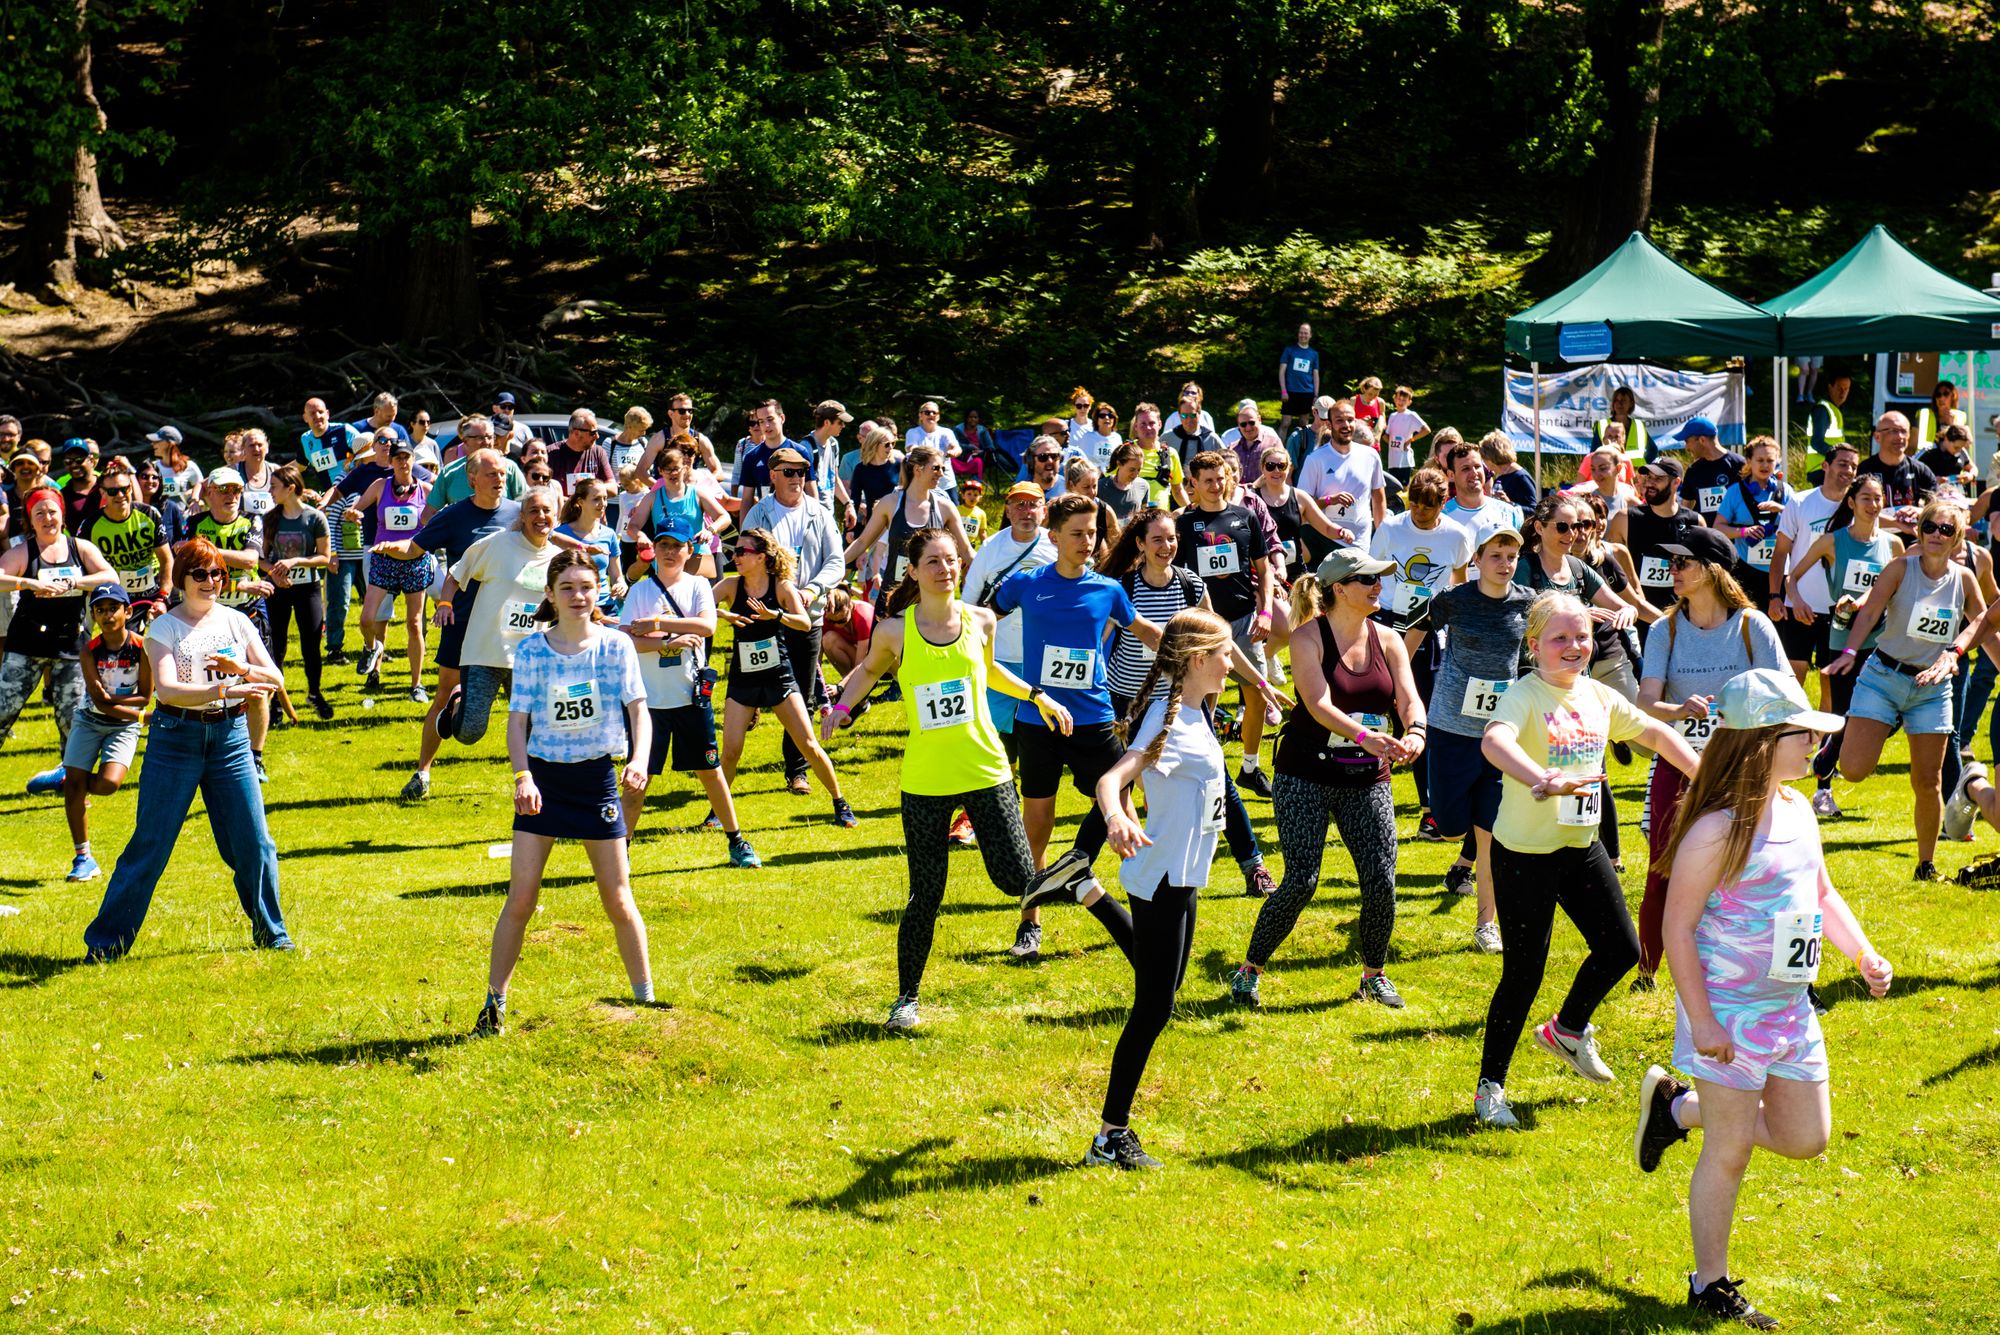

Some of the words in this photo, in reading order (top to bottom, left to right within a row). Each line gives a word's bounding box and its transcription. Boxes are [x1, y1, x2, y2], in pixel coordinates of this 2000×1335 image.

[1555, 391, 1608, 411] Are
[1645, 410, 1710, 428] ommunity
[316, 455, 331, 467] 141
[253, 500, 266, 509] 30
[1704, 495, 1723, 507] 124
[1338, 506, 1345, 517] 4
[393, 515, 409, 526] 29
[97, 527, 154, 555] OAKS
[1209, 555, 1228, 570] 60
[126, 575, 148, 588] 271
[1647, 567, 1671, 582] 237
[509, 612, 535, 629] 209
[1917, 616, 1950, 637] 228
[750, 650, 769, 666] 89
[1050, 660, 1087, 681] 279
[1719, 664, 1740, 672] LABE
[554, 697, 595, 721] 258
[926, 694, 967, 720] 132
[1475, 693, 1502, 712] 13
[1683, 718, 1717, 738] 25
[1575, 791, 1599, 816] 140
